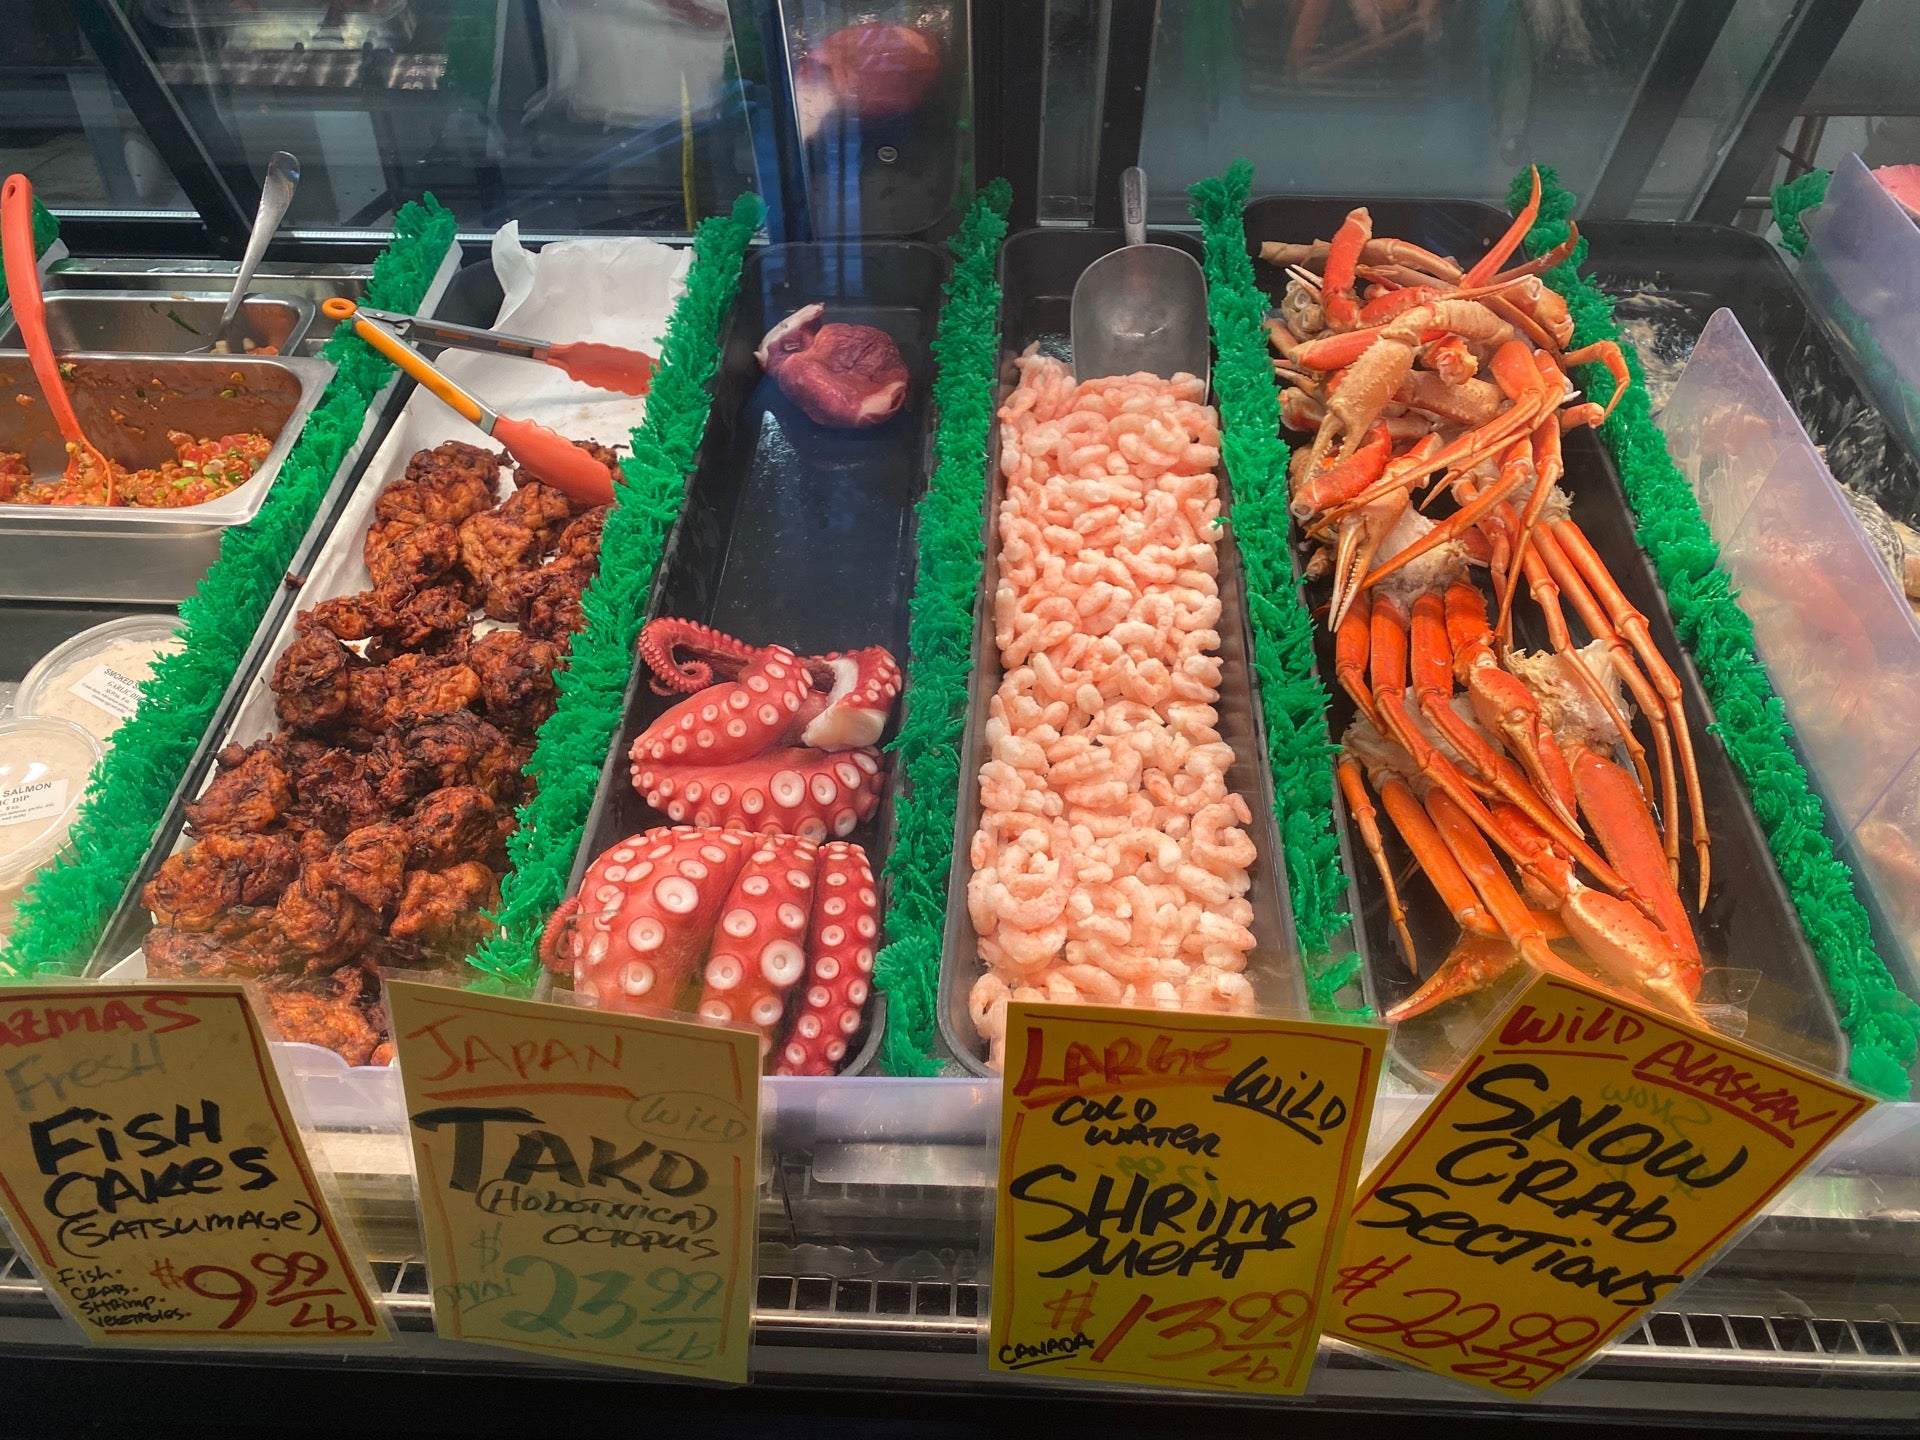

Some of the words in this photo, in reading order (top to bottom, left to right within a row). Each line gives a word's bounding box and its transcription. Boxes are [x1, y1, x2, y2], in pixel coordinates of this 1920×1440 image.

[104, 668, 135, 687] SMOKED
[107, 680, 132, 697] GARLIC
[2, 781, 52, 798] SALMON
[12, 794, 30, 804] DIP
[405, 1014, 624, 1081] JAPAN
[1632, 1040, 1838, 1131] ALASKAN
[1052, 1094, 1158, 1126] COLD
[1453, 1063, 1749, 1189] SNOW
[409, 1106, 710, 1198] TAKO
[542, 1223, 721, 1262] OCTOPUS
[998, 1331, 1095, 1365] CANADA
